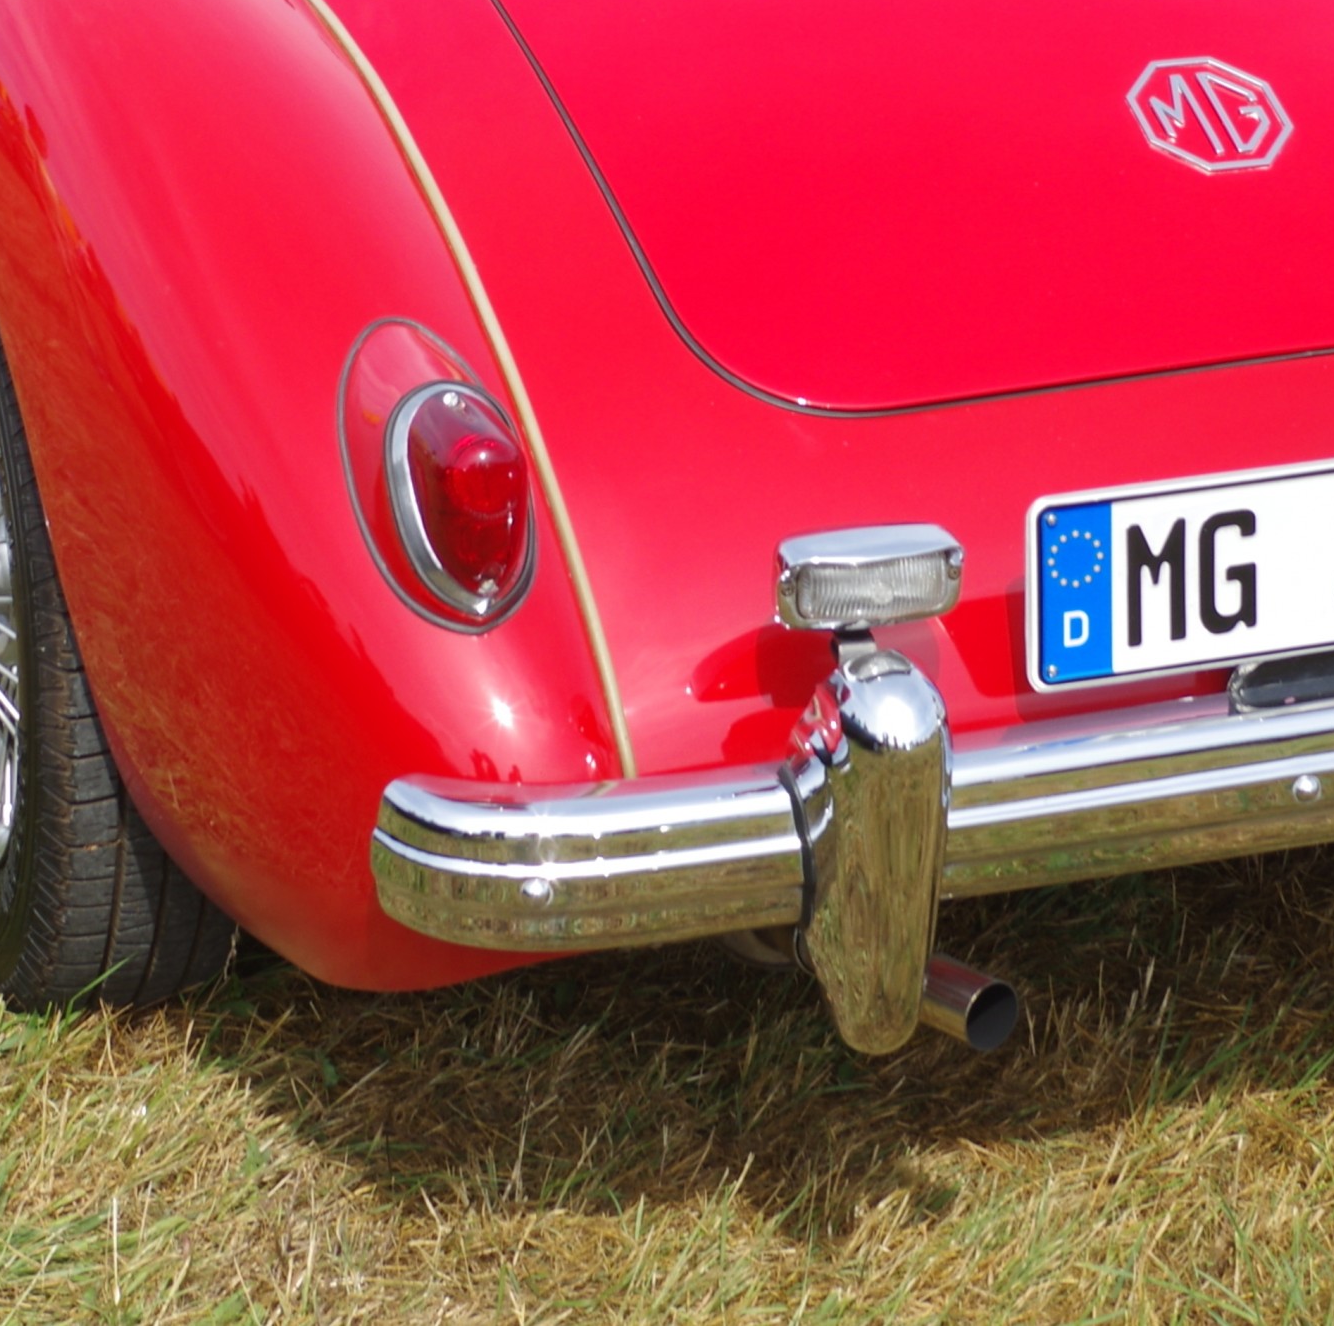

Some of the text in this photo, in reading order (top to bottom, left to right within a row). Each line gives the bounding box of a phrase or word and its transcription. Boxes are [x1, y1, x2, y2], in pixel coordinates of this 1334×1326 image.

[1147, 70, 1273, 157] MG
[1062, 609, 1090, 648] D
[1126, 508, 1258, 648] MG
